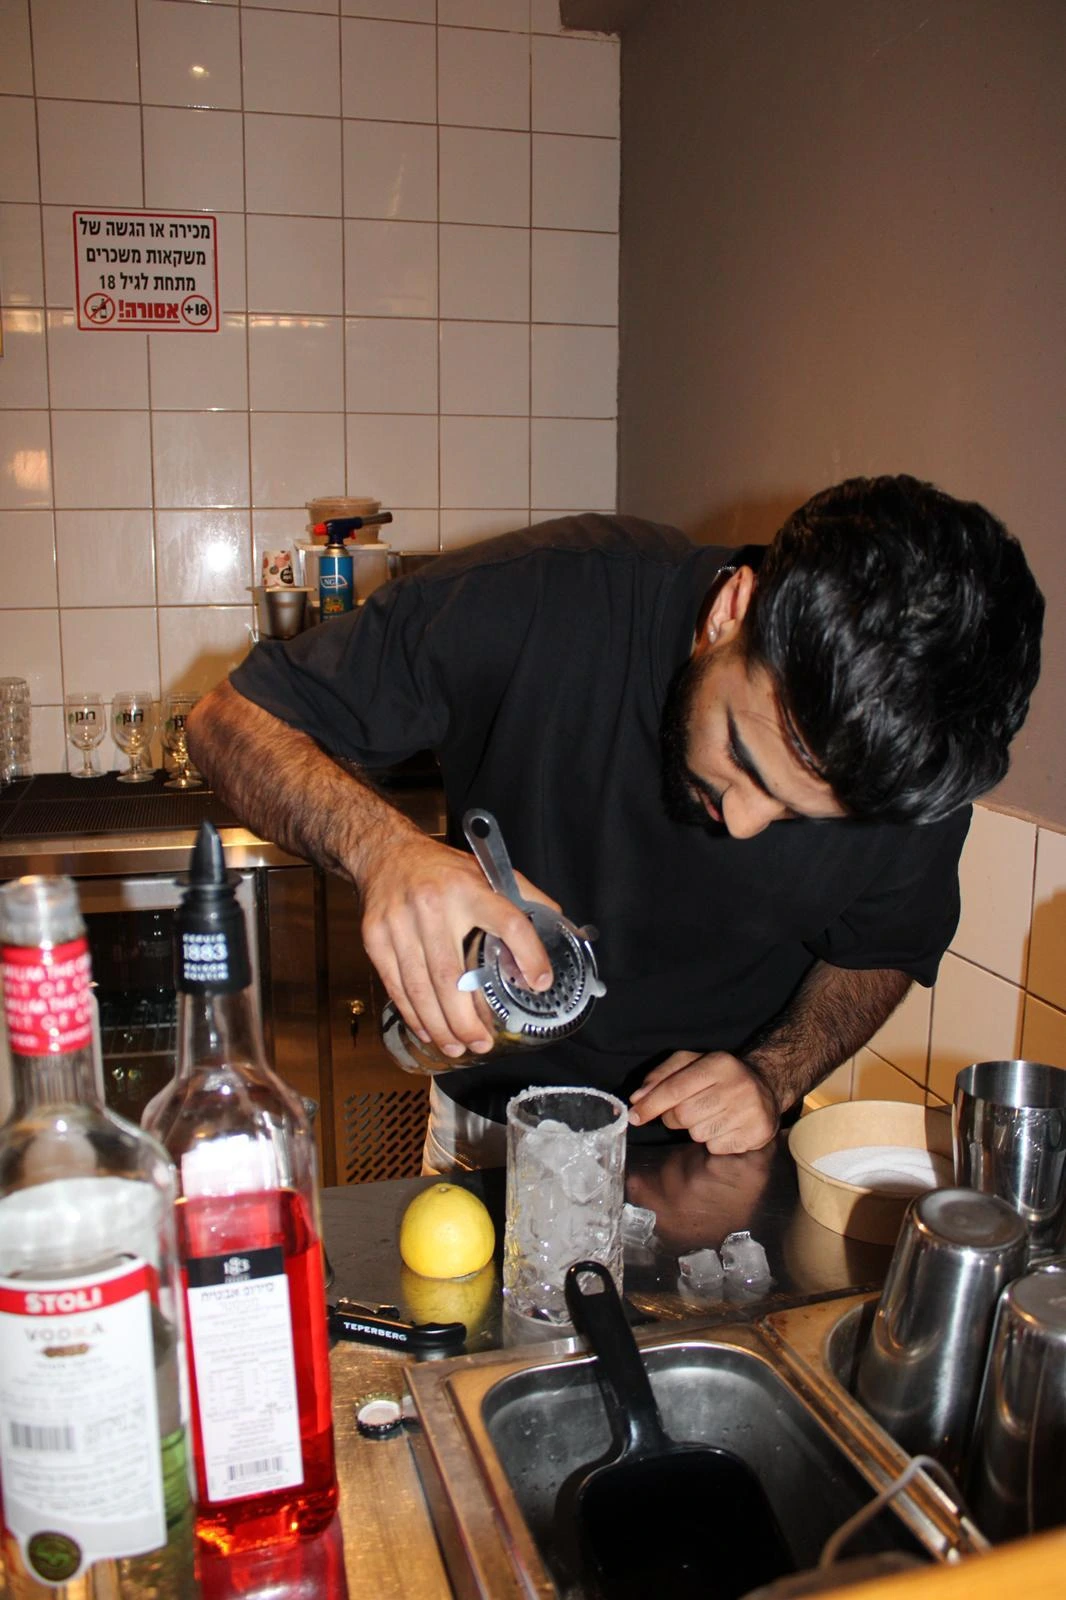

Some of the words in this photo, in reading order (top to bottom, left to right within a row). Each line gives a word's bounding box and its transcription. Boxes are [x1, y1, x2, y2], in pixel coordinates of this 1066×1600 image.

[79, 217, 101, 235] של
[106, 221, 145, 237] הגשה
[150, 222, 165, 238] או
[169, 223, 210, 239] מכירה
[86, 247, 142, 263] משכרים
[146, 249, 206, 268] משקאות
[99, 275, 116, 290] 18
[119, 272, 149, 290] לגיל
[153, 276, 196, 291] מתחת
[118, 299, 179, 319] אסורה!
[183, 942, 229, 962] 1883
[24, 1286, 103, 1314] STOLI
[343, 1321, 408, 1342] TEPERBERG
